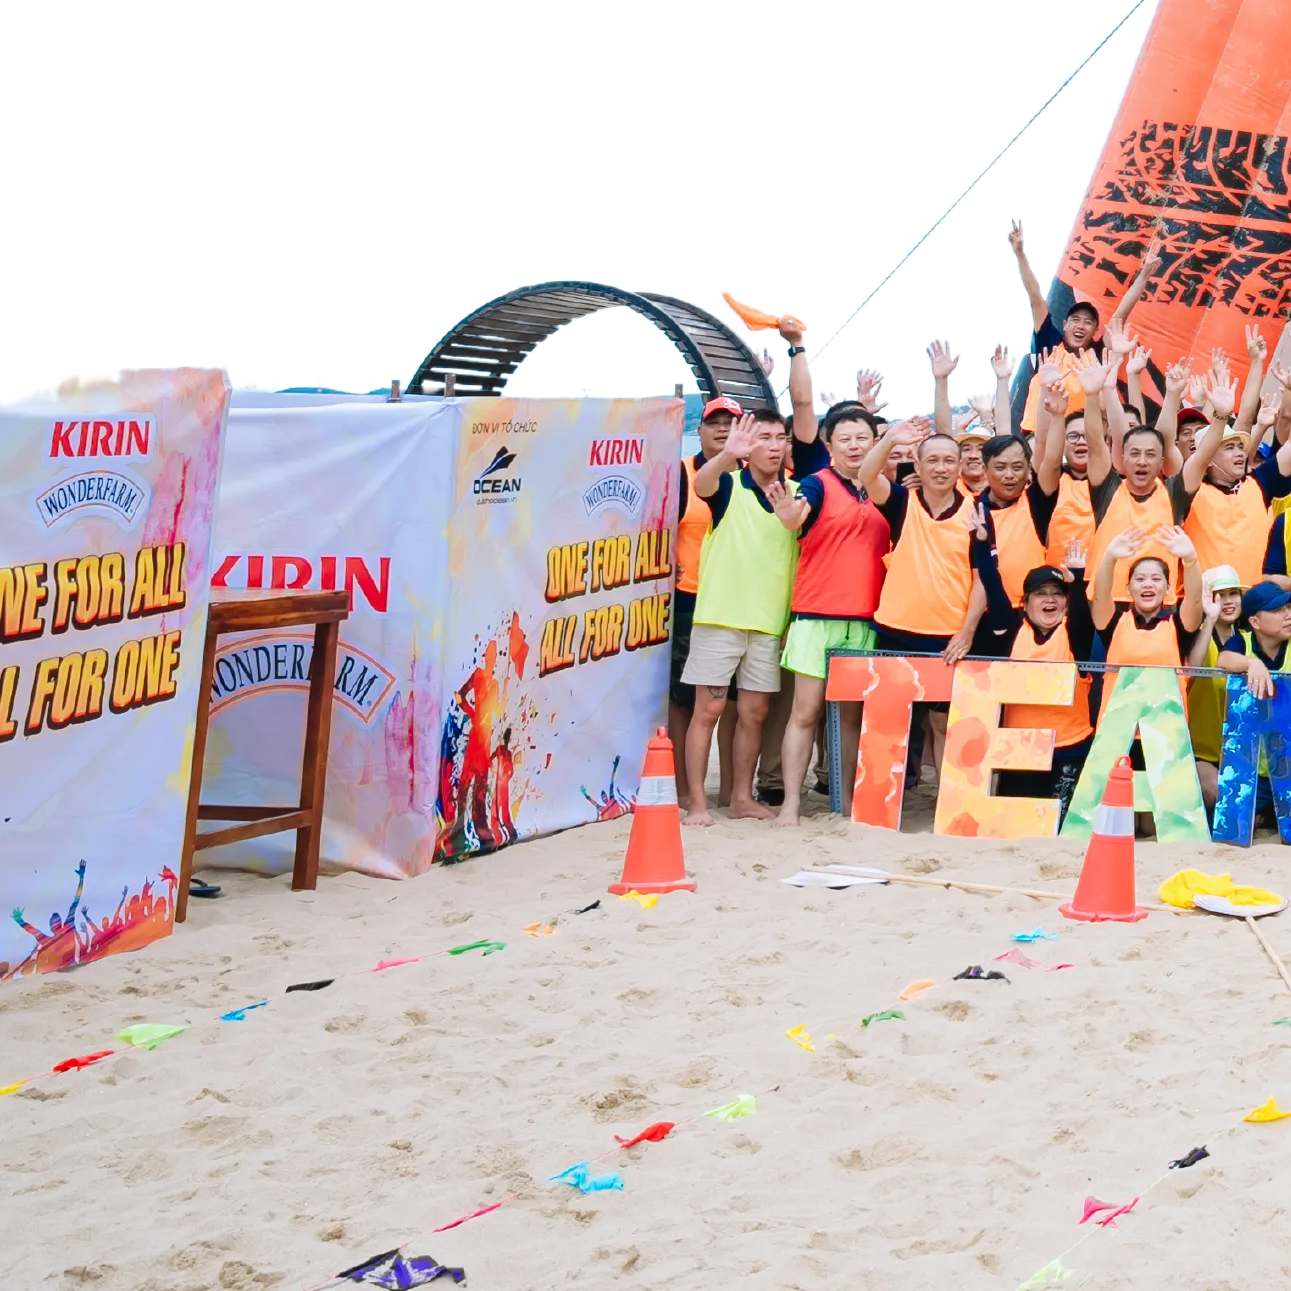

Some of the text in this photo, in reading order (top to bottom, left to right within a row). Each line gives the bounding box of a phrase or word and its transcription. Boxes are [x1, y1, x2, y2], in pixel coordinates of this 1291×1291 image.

[49, 419, 151, 458] KIRIN
[589, 438, 645, 467] KIRIN
[43, 477, 137, 518] WONDERFARM
[473, 477, 522, 495] OCEAN
[585, 479, 638, 509] WONDERFARM
[545, 528, 672, 603] ONE FOR ALL
[0, 542, 186, 644] NE FOR ALL
[538, 593, 671, 678] ALL FOR ONE
[24, 647, 109, 737] FOR
[110, 630, 182, 715] ONE
[209, 644, 379, 706] ONDERRM
